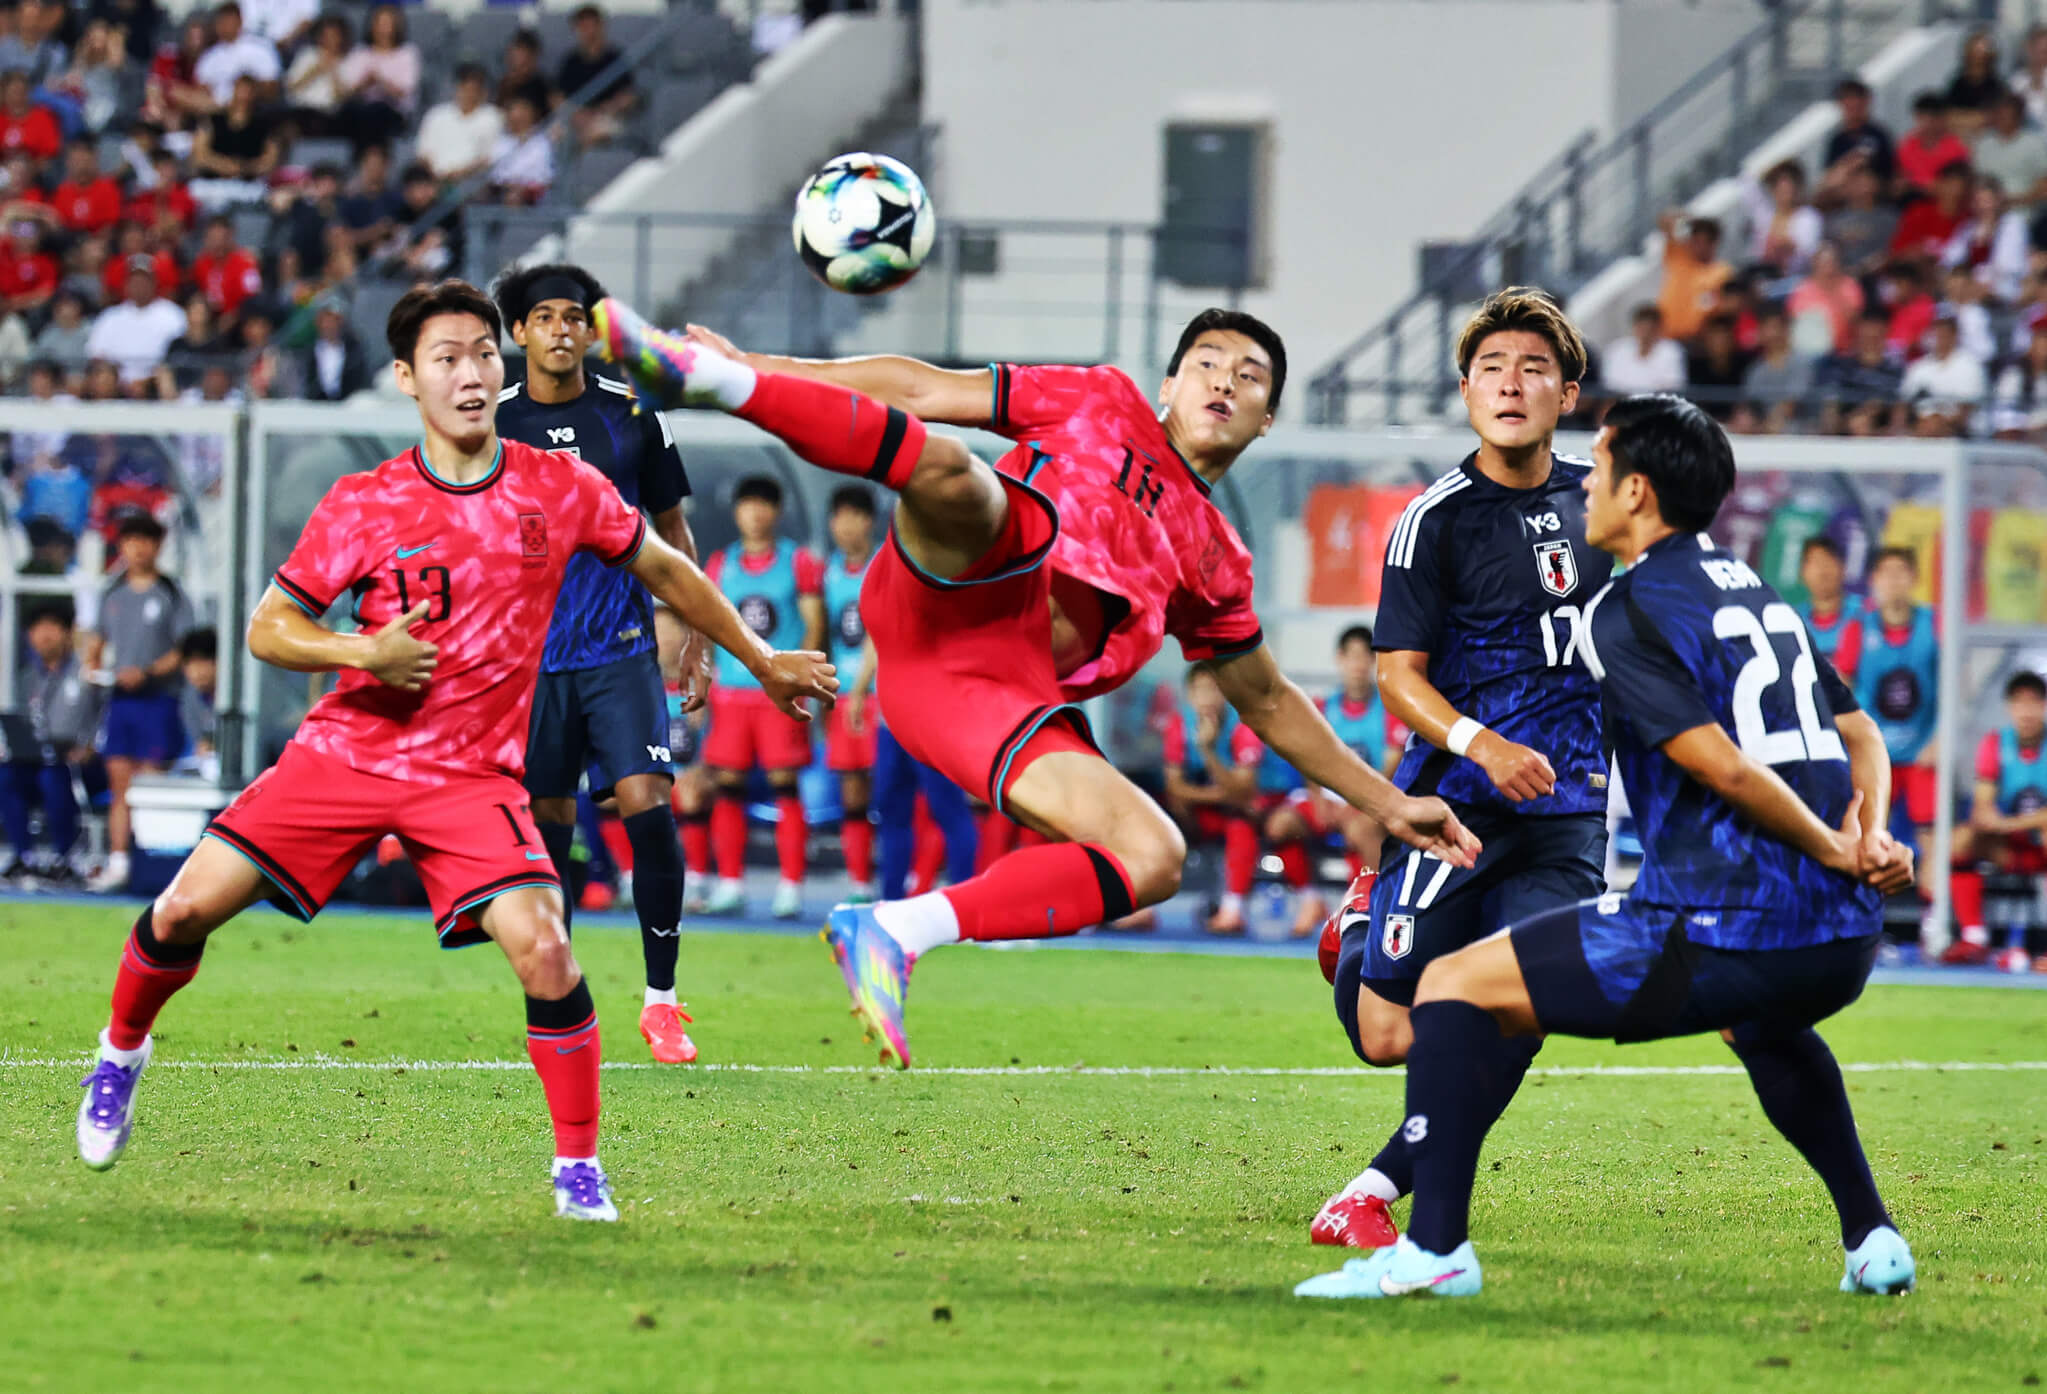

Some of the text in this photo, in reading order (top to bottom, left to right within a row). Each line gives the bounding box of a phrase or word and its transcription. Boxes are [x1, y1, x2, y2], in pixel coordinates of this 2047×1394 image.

[546, 427, 576, 444] Y-3
[1526, 512, 1561, 534] Y-3
[391, 565, 452, 623] 13
[1540, 605, 1582, 667] 17
[1712, 603, 1848, 766] 22
[1398, 849, 1453, 910] 17
